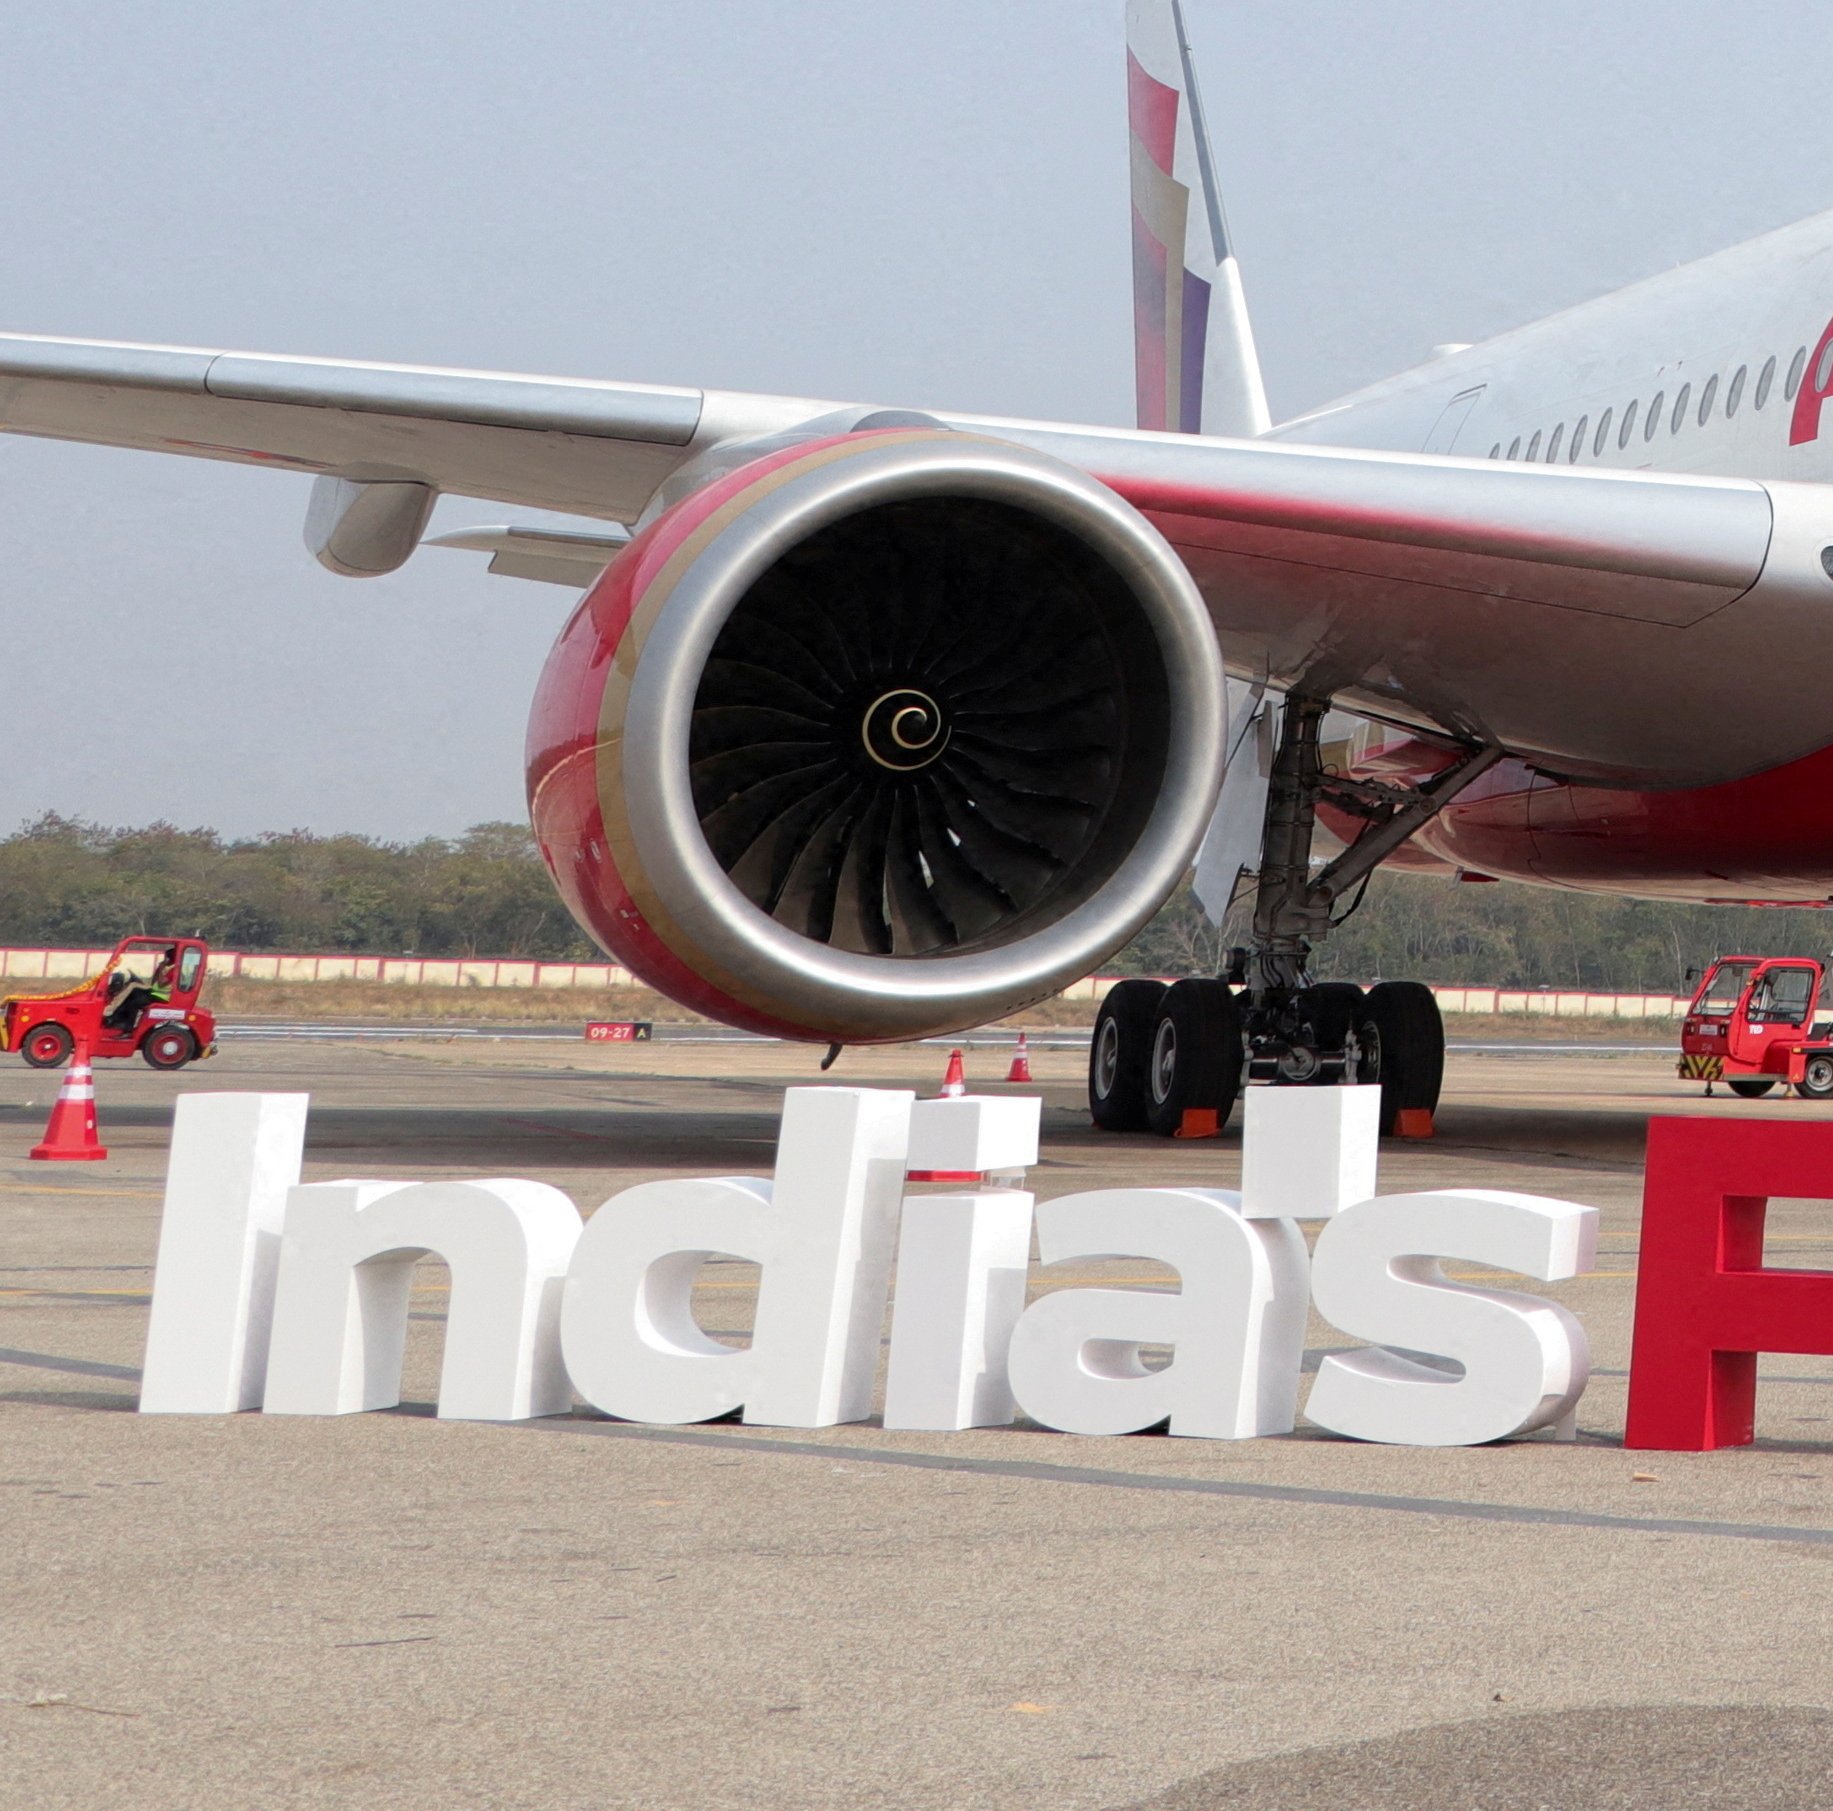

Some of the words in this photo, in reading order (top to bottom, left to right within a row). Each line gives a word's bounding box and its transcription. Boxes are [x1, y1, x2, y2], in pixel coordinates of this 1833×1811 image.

[591, 1027, 631, 1039] 09-27
[637, 1027, 647, 1039] A
[139, 1083, 1600, 1447] India's
